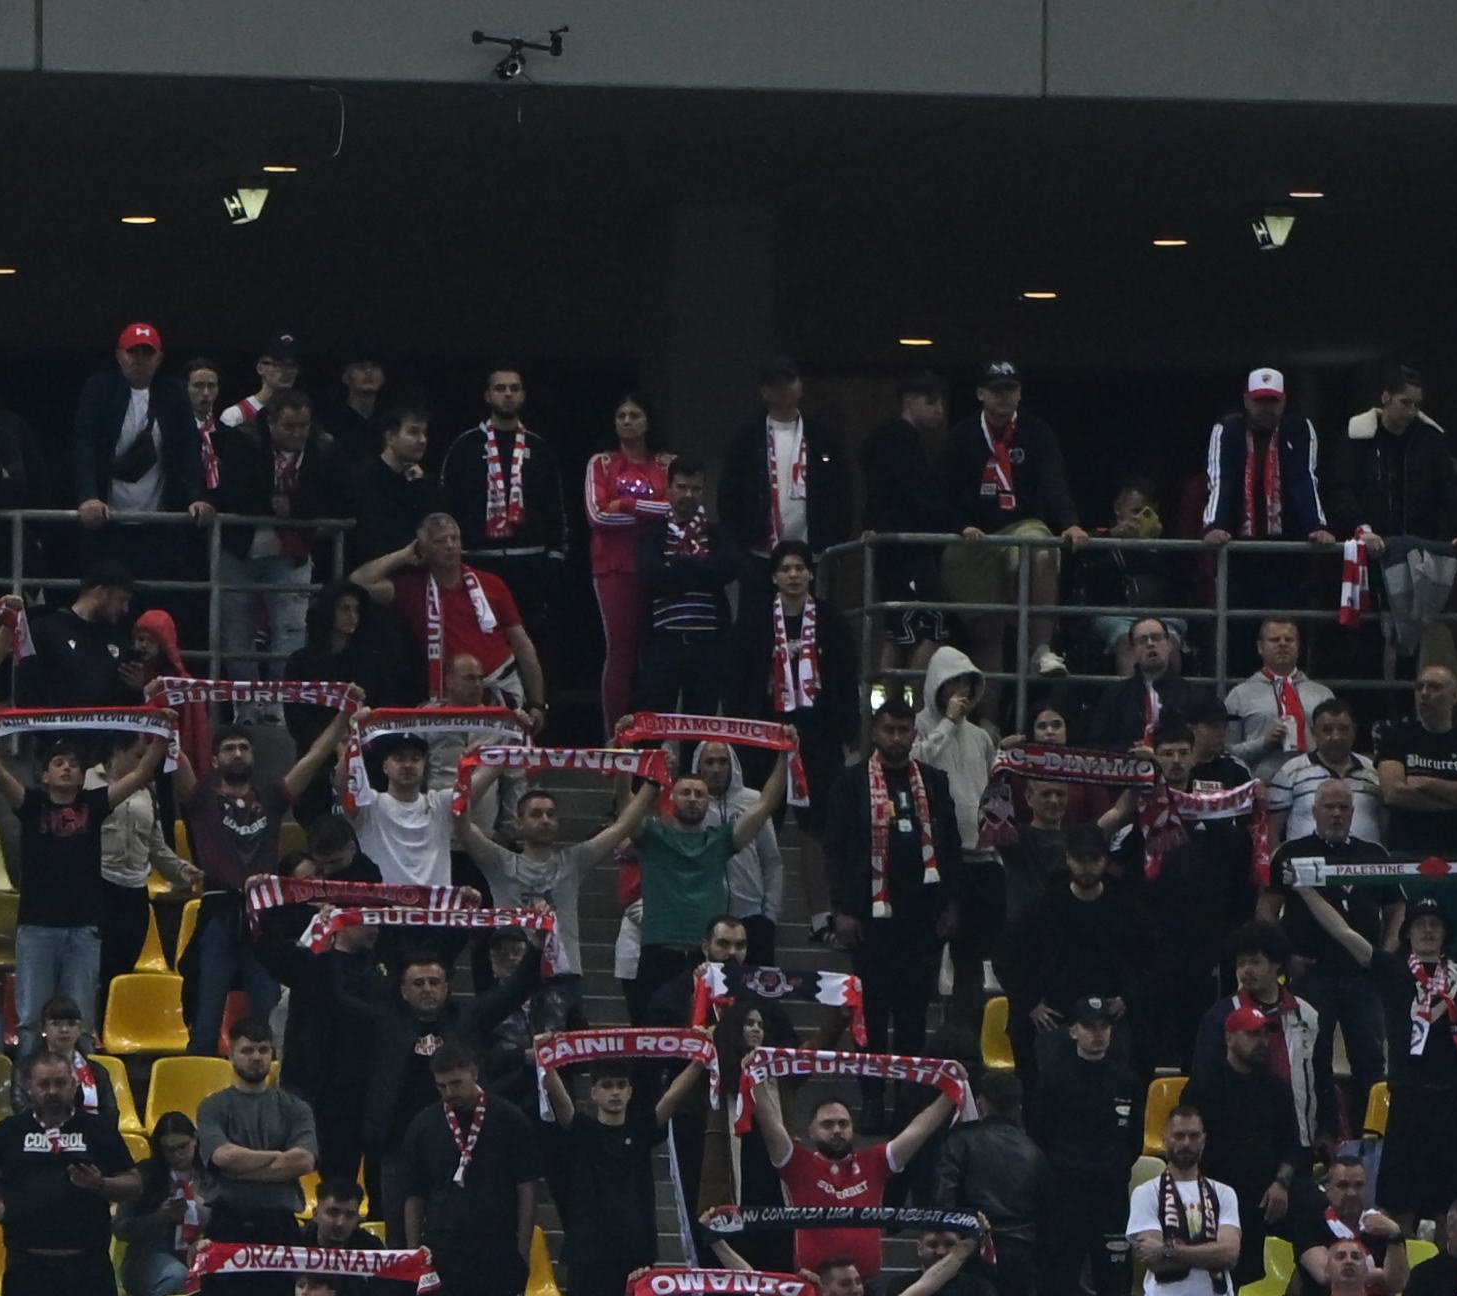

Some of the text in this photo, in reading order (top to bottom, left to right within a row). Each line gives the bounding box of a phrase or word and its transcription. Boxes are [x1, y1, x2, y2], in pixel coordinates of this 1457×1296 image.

[168, 689, 346, 708] BUCURESTI
[478, 749, 641, 771] DINAMO
[1046, 752, 1157, 777] DINAMO
[1335, 862, 1405, 876] PALESTINE
[361, 909, 542, 929] BUCURESTI
[750, 1058, 945, 1087] BUCURESTI
[305, 1251, 413, 1275] DINAMO
